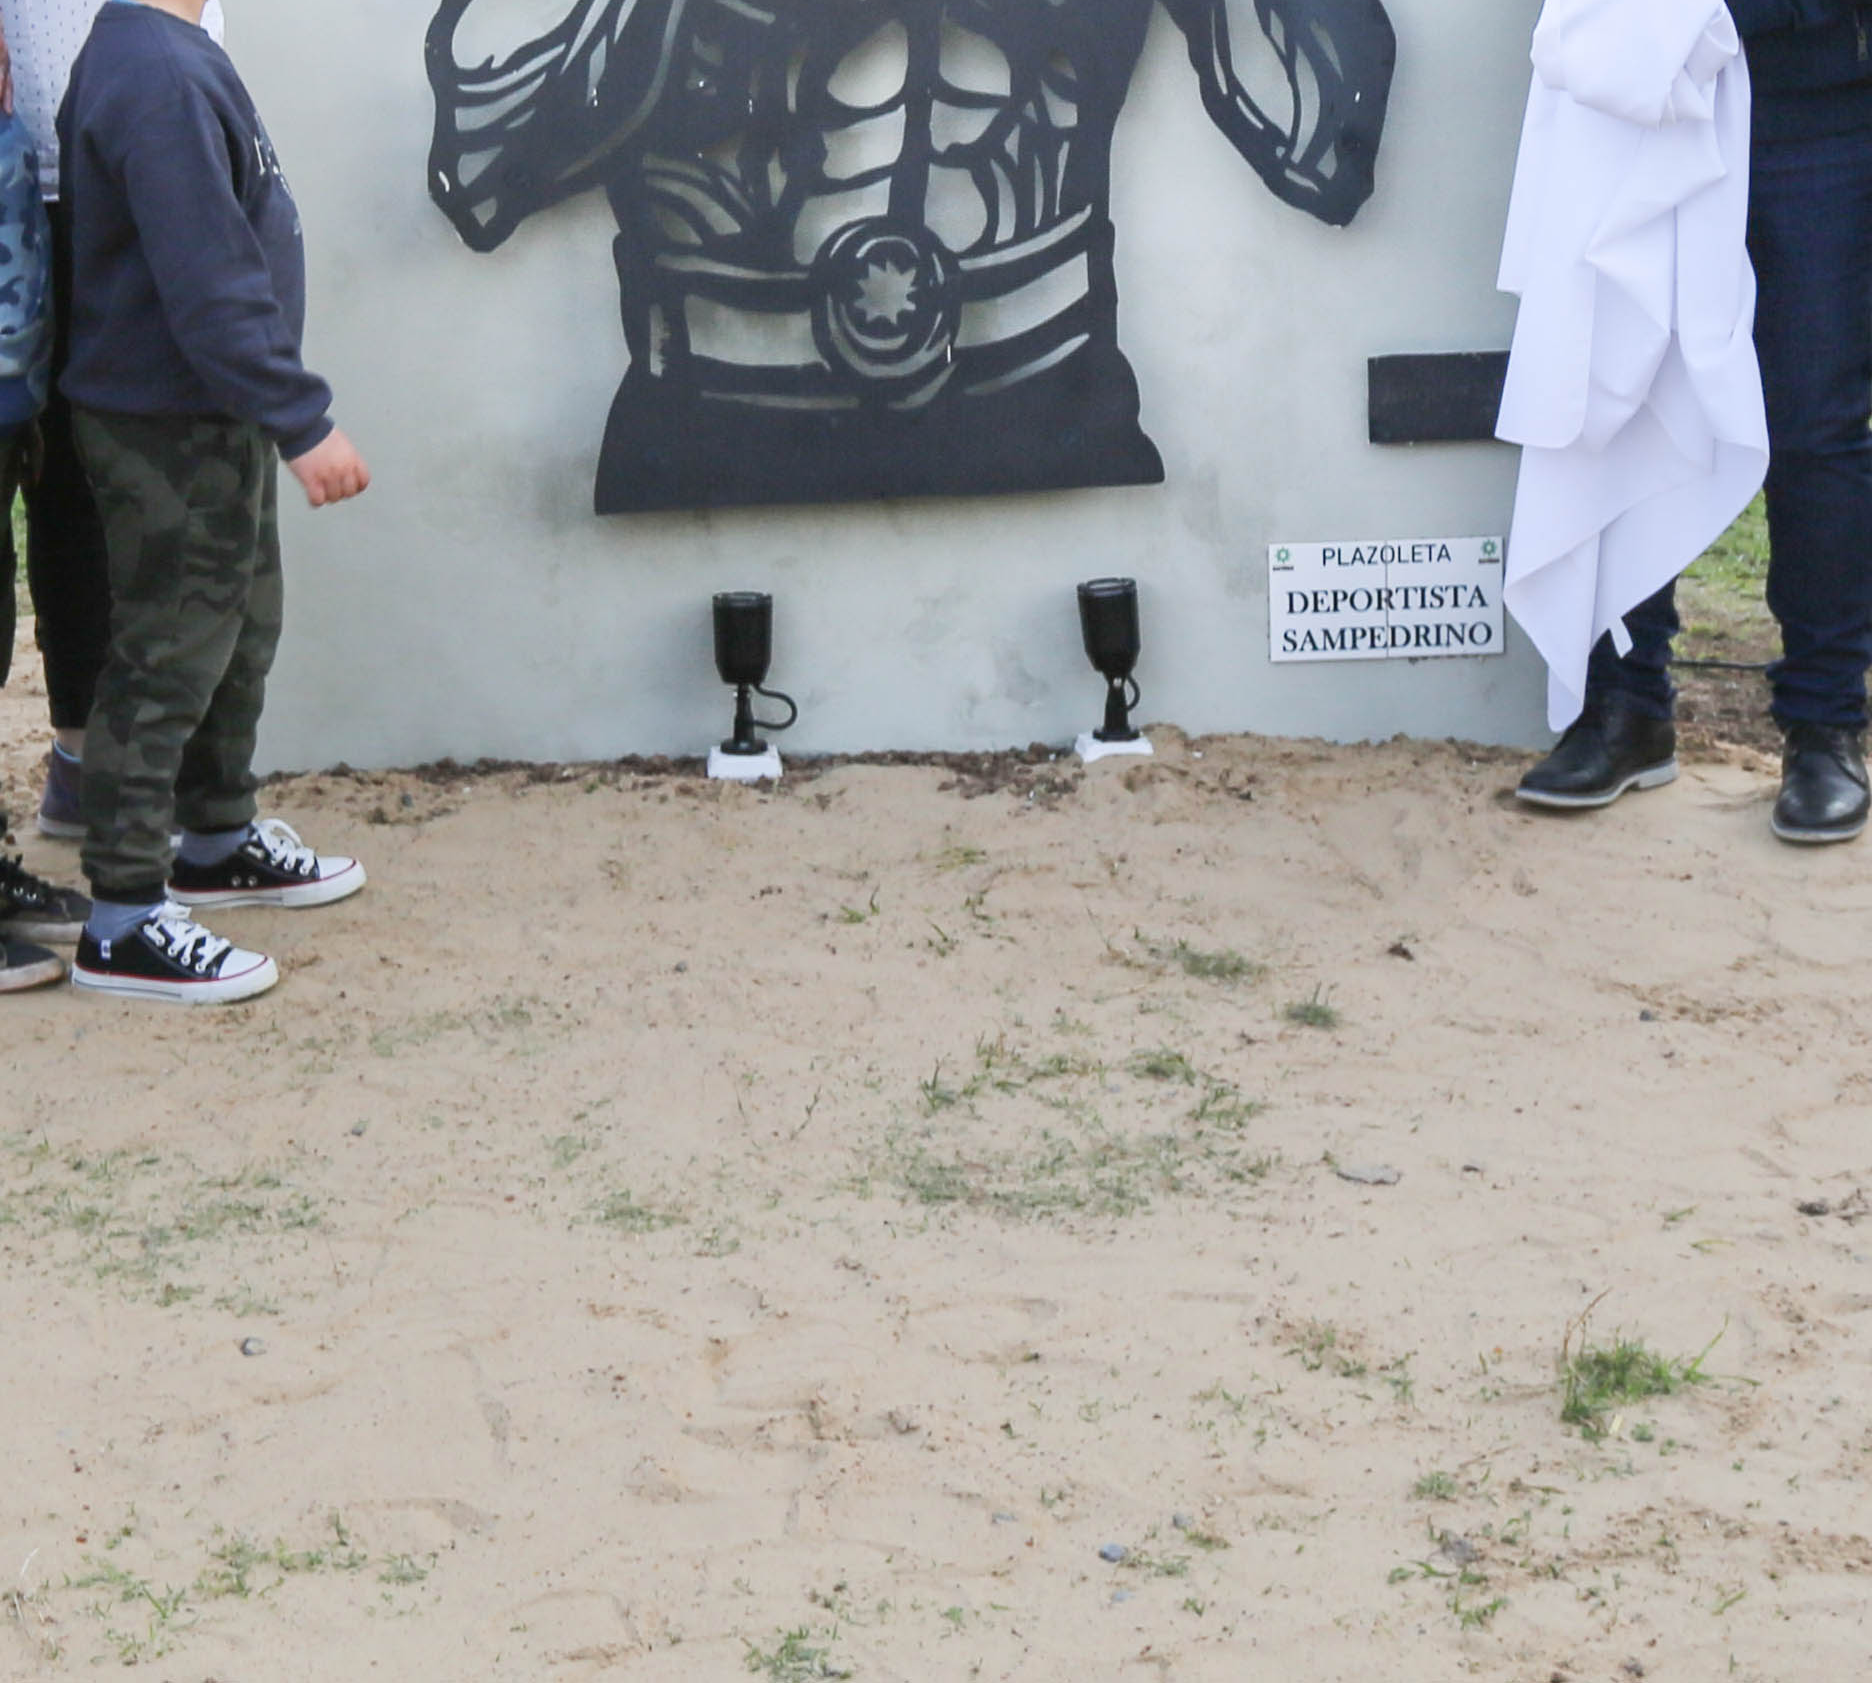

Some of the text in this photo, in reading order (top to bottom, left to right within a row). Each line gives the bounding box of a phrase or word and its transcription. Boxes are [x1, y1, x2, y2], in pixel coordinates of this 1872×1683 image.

[1322, 543, 1452, 567] PLAZOLETA
[1286, 584, 1489, 615] DEPORTISTA
[1282, 621, 1493, 653] SAMPEDRINO
